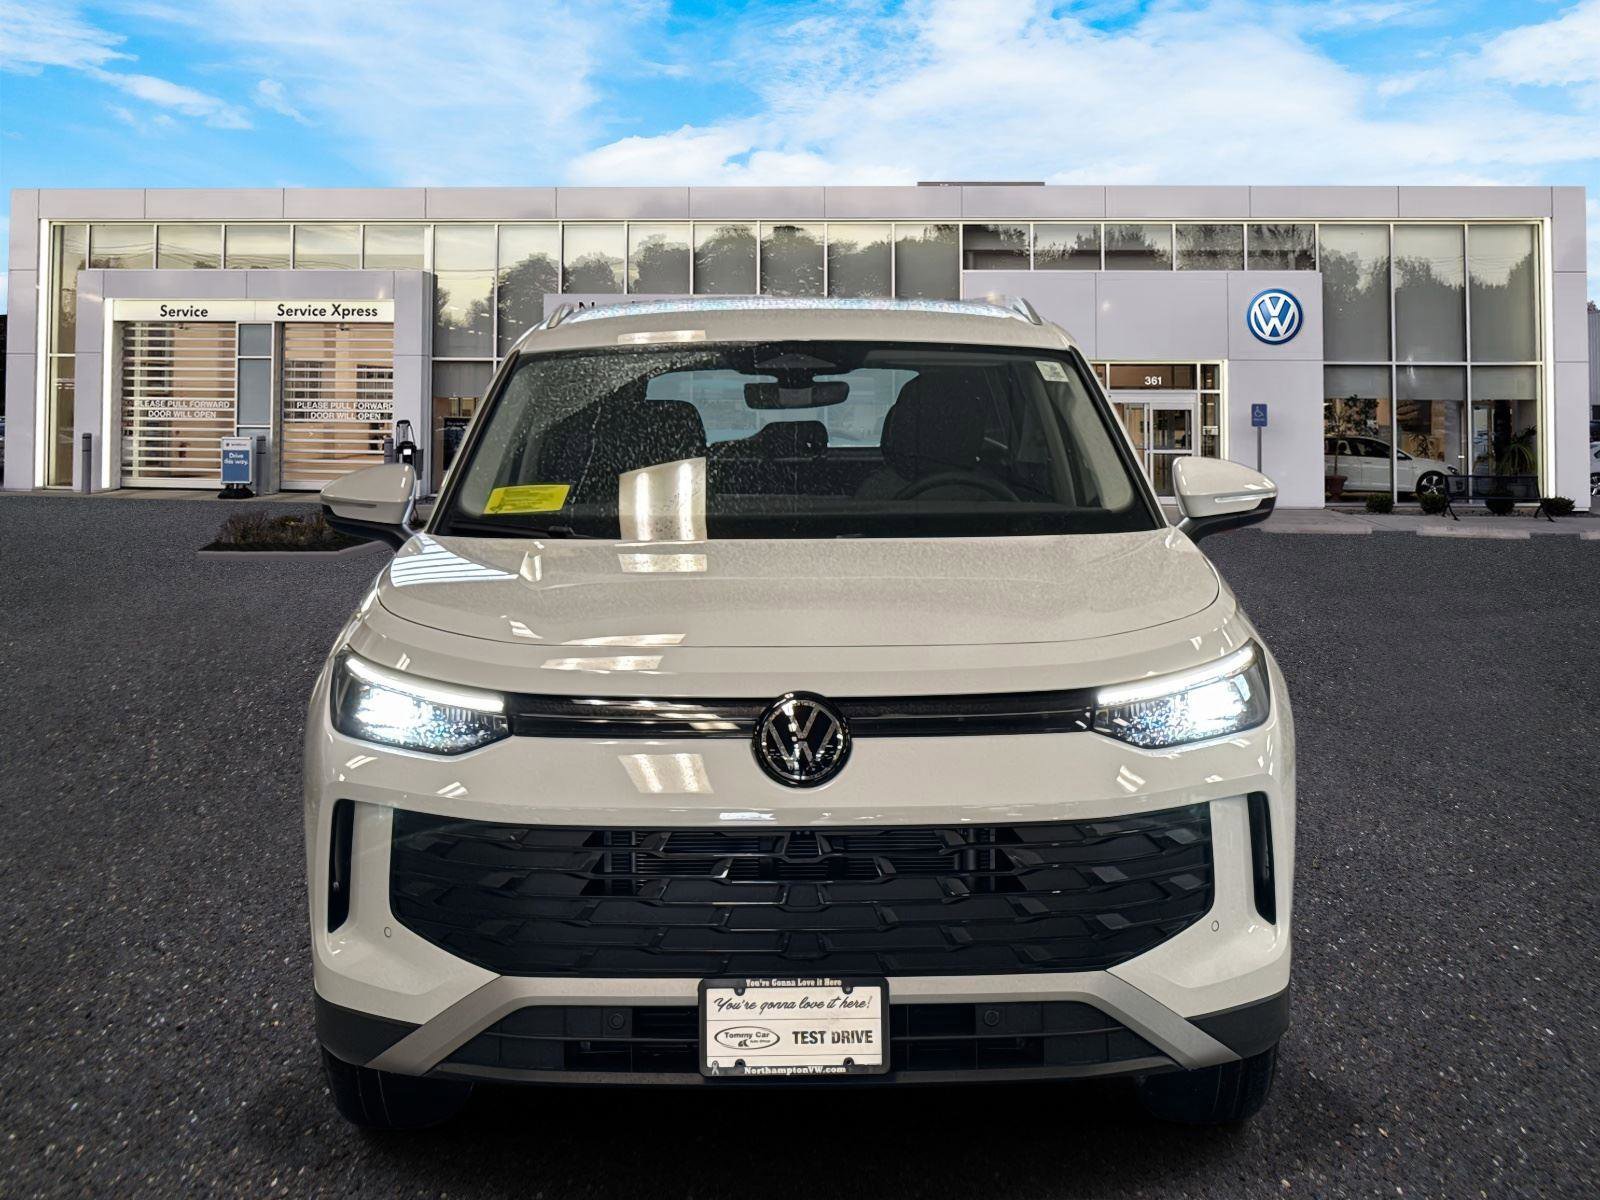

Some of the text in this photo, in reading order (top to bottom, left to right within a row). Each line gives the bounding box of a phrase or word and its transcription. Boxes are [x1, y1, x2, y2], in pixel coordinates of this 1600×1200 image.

[159, 304, 209, 318] Service
[277, 303, 378, 320] Service Xpress
[1144, 376, 1162, 385] 361
[167, 400, 188, 408] PULL
[189, 400, 230, 409] FORWARD
[296, 401, 394, 410] PLEASE PULL FORWARD
[148, 410, 217, 418] DOOR WILL OPEN
[310, 412, 381, 420] DOOR WILL OPEN
[745, 979, 770, 987] You're
[771, 978, 796, 987] Gonna
[797, 978, 815, 986] Love
[824, 978, 842, 986] Here
[713, 995, 872, 1015] You're gonna love it here!
[724, 1031, 753, 1040] Tommy
[792, 1029, 874, 1045] TEST DRIVE
[744, 1065, 846, 1076] NorthamptonVW.com
